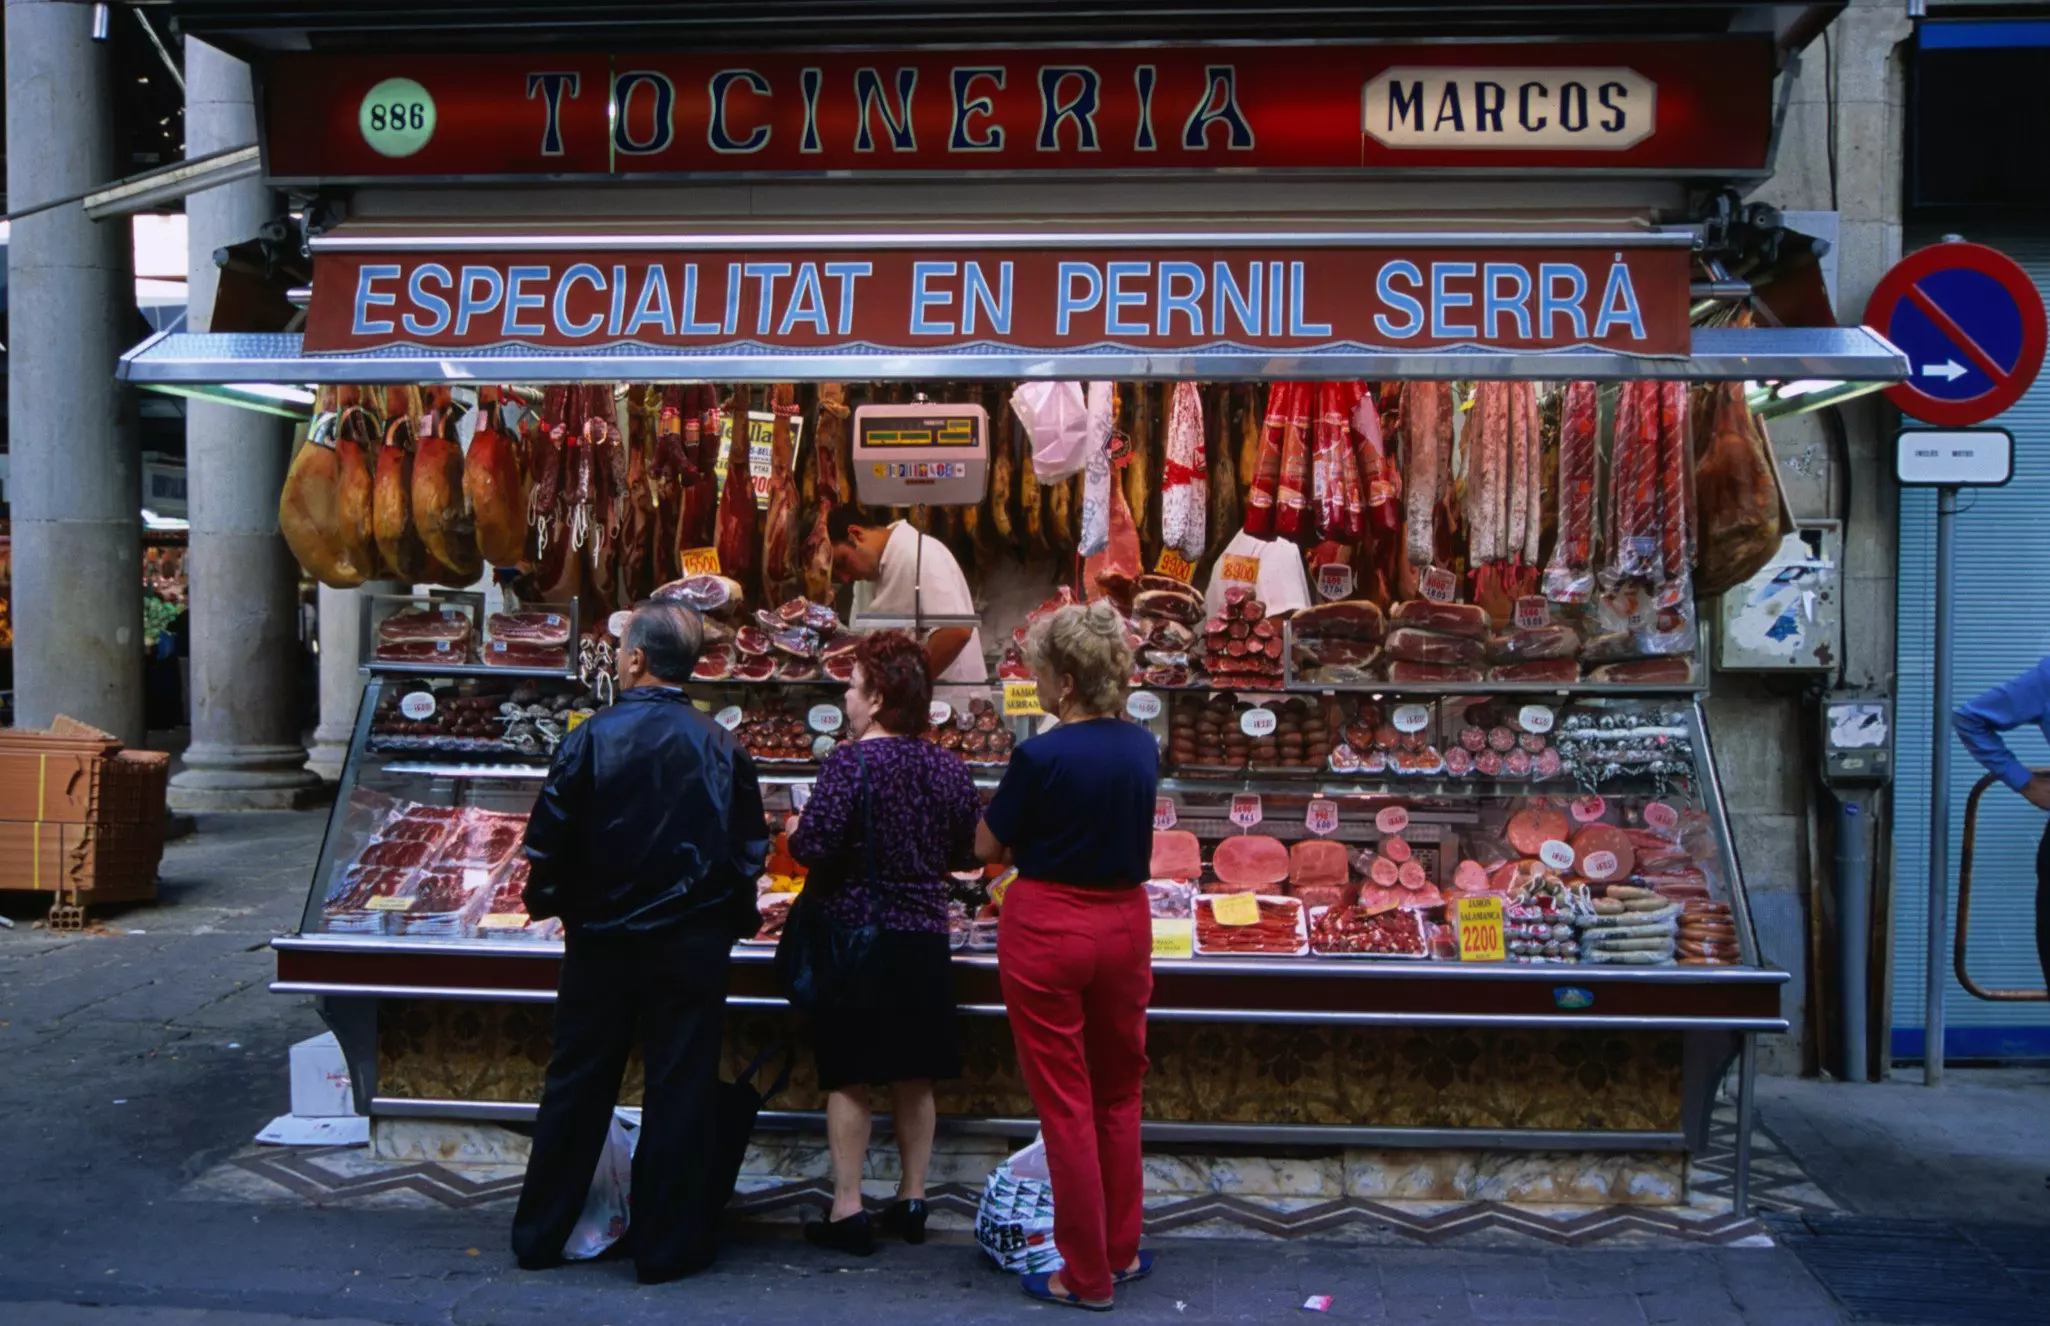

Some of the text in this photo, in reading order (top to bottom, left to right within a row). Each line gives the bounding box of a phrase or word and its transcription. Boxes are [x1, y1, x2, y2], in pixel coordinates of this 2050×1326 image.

[371, 103, 425, 131] 886
[526, 65, 1255, 155] TOCINERIA
[1387, 80, 1629, 133] MARCOS
[351, 262, 873, 338] ESPECIALITAT
[909, 261, 1014, 335] EN
[1055, 261, 1332, 338] PERNIL
[1460, 911, 1501, 921] SALAMANCA
[1463, 924, 1497, 953] 2200
